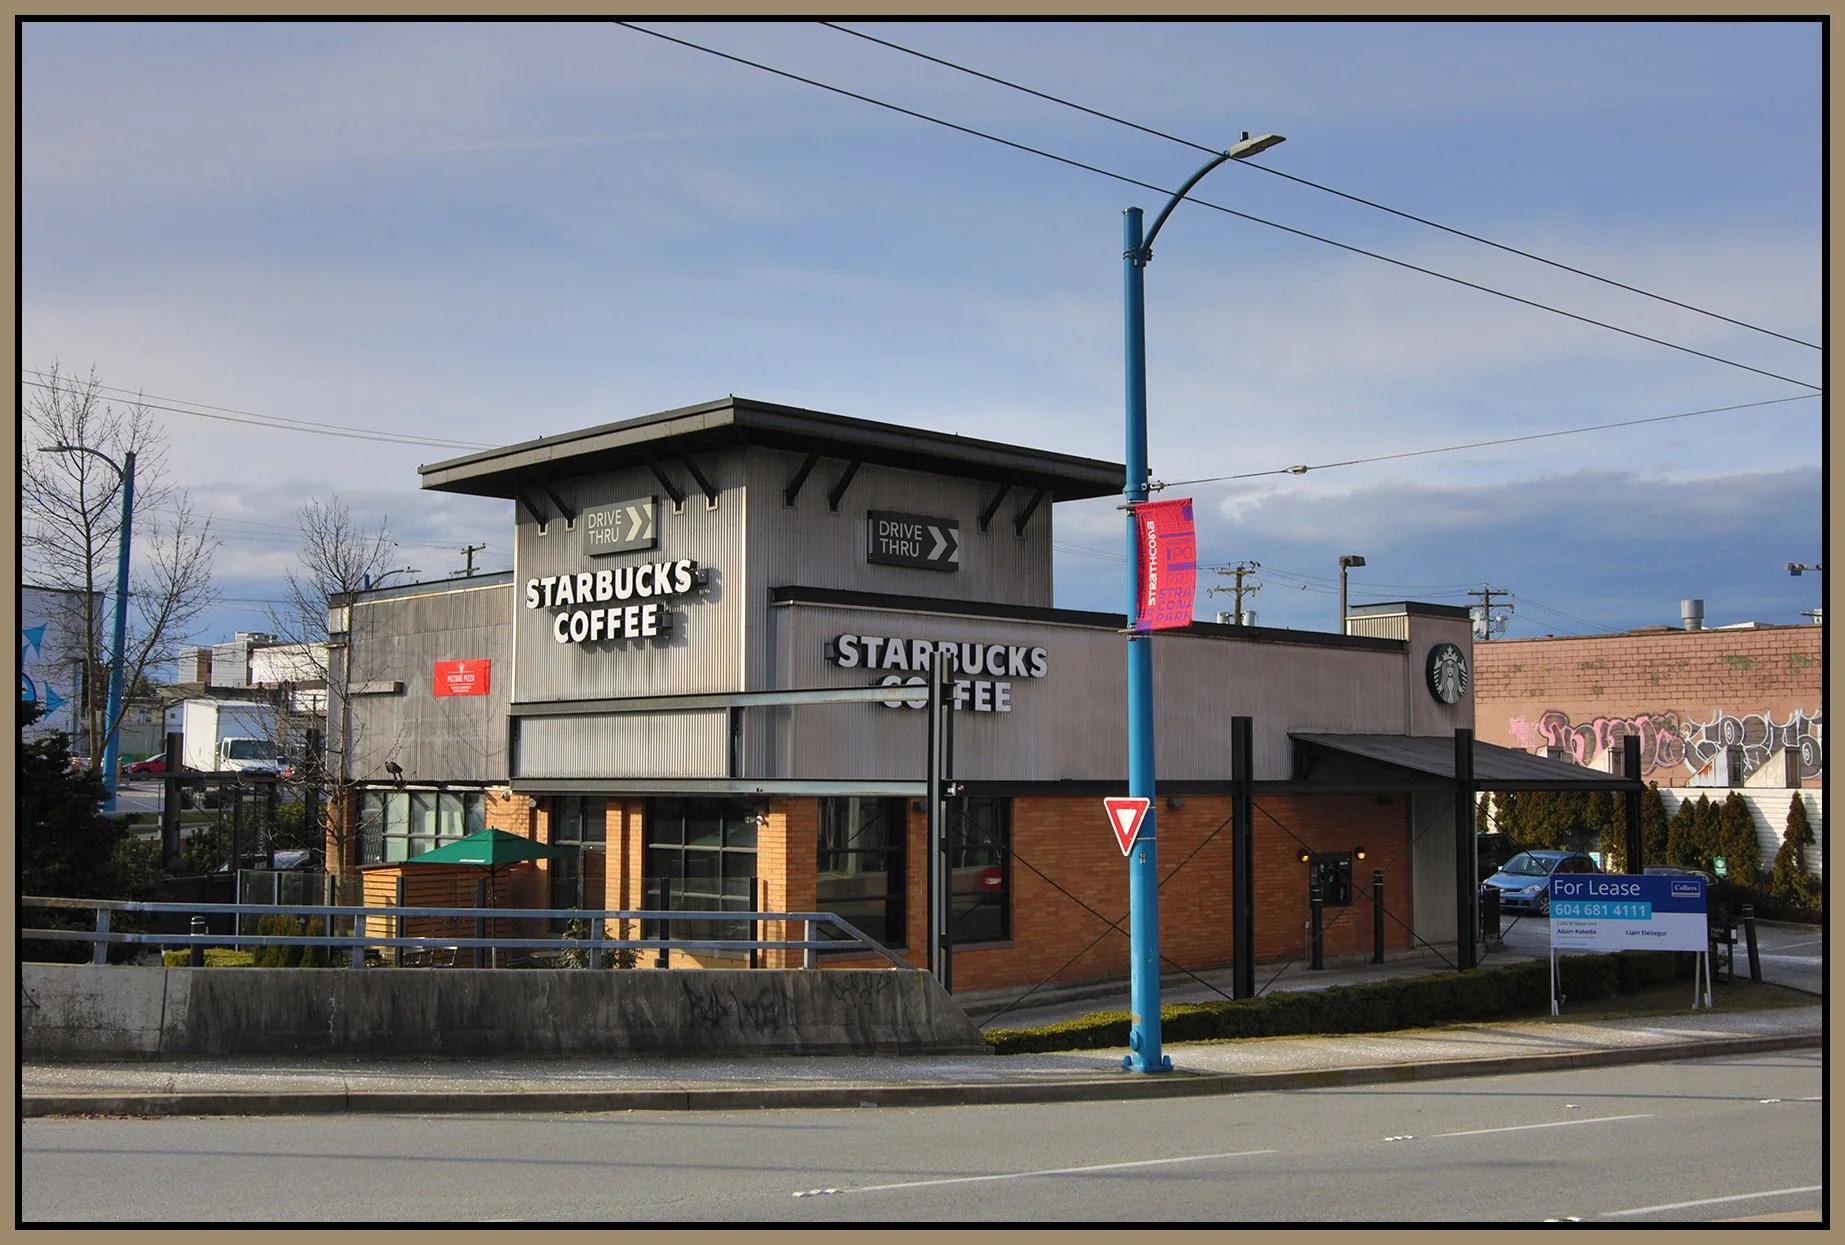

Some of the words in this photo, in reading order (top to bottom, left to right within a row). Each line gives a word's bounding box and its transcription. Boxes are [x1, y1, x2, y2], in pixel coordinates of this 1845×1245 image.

[588, 508, 622, 529] DRIVE
[588, 527, 620, 546] THRU
[879, 520, 923, 541] DRIVE
[879, 537, 920, 558] THRU
[526, 558, 693, 609] STARBUCKS
[553, 603, 658, 644] COFFEE
[881, 674, 1012, 713] COFEE
[1554, 879, 1583, 896] For
[1589, 880, 1641, 897] Lease
[1674, 884, 1698, 892] Colliers
[1555, 903, 1580, 916] 604
[1584, 904, 1608, 917] 681
[1612, 904, 1646, 918] 4111
